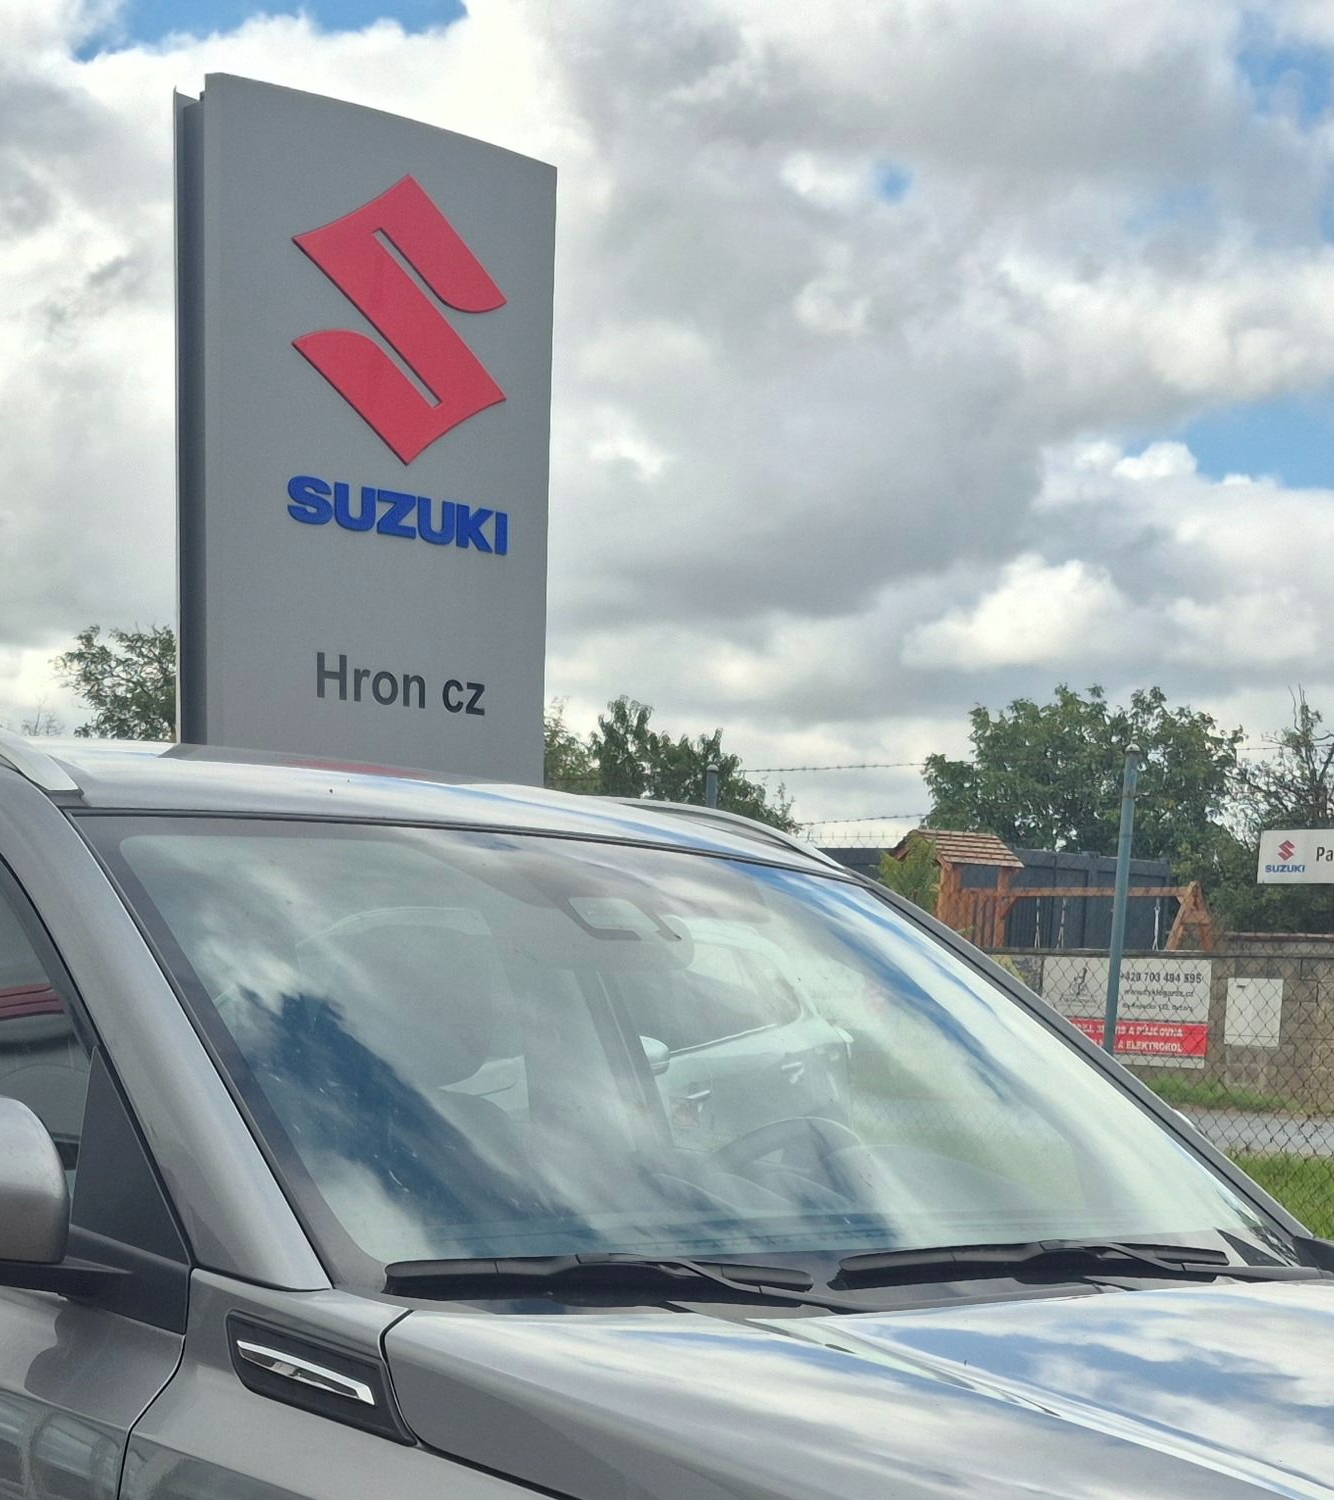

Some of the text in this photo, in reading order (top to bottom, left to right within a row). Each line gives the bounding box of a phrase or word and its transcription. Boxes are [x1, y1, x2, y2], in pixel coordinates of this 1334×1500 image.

[287, 476, 508, 556] SUZUKI
[316, 652, 485, 716] Hron cz
[1265, 864, 1306, 873] SUZUKI
[1144, 972, 1161, 982] 703
[1127, 1026, 1135, 1035] A
